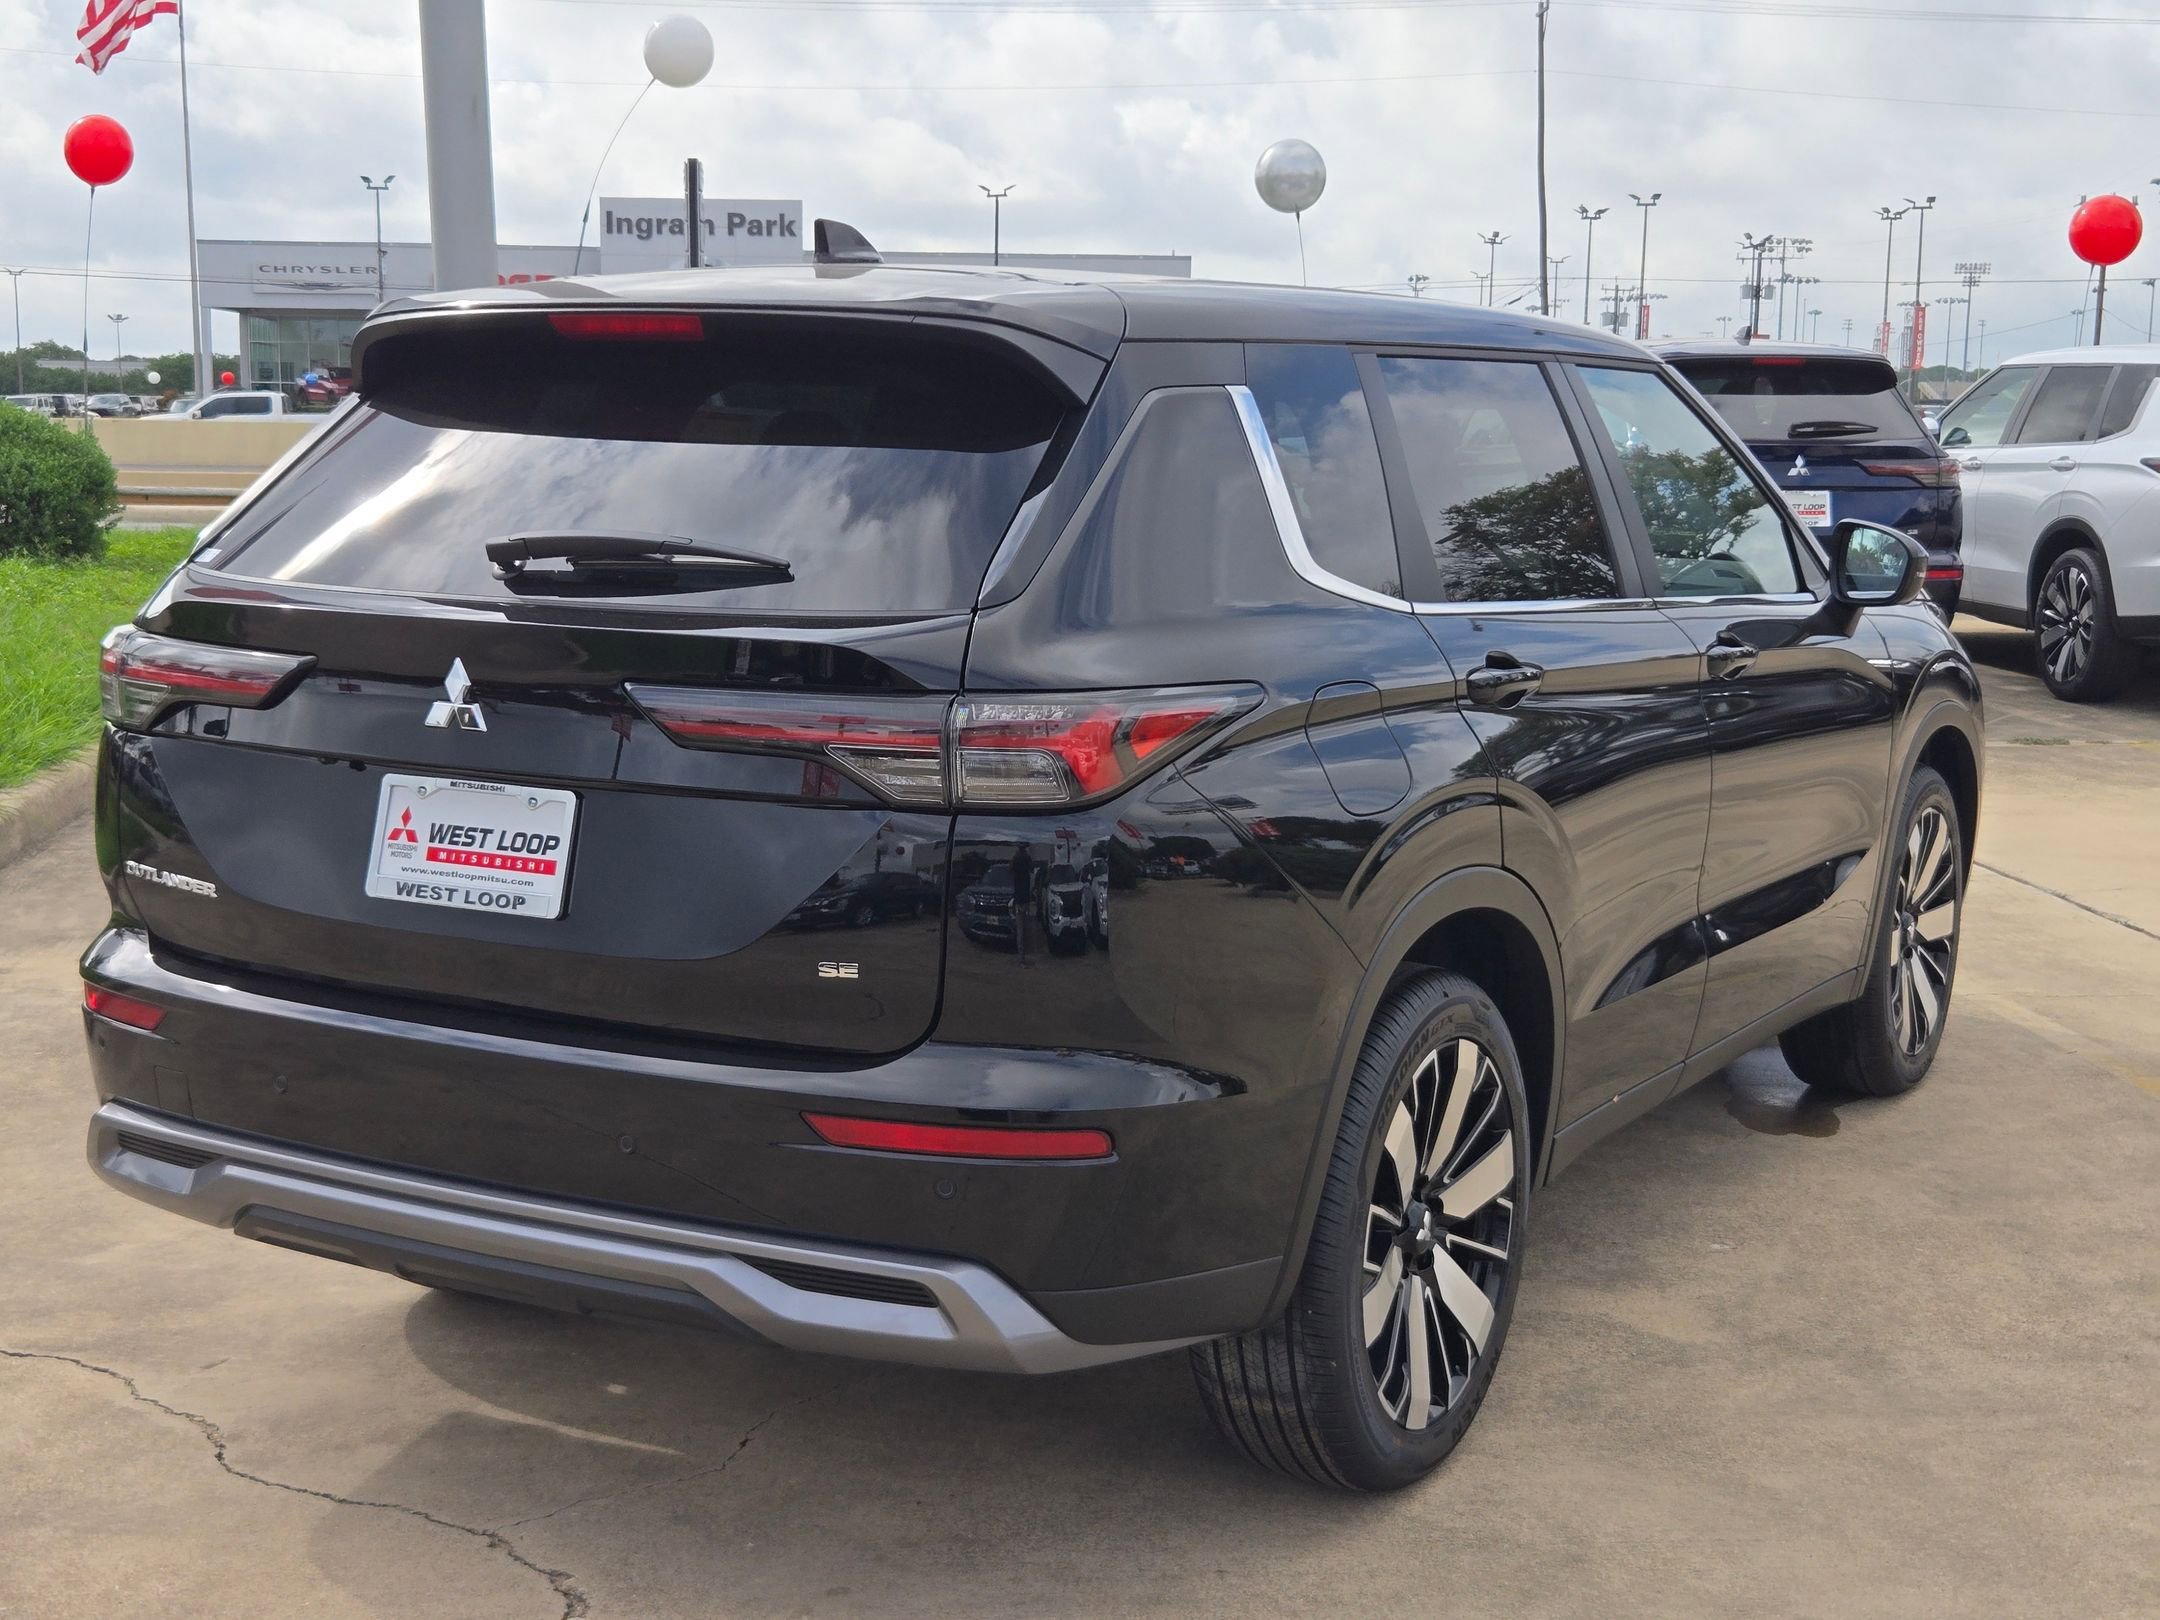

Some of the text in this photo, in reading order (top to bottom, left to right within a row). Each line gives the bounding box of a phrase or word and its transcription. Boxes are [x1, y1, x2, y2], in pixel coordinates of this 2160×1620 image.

[727, 212, 797, 237] Park
[259, 264, 378, 275] CHRYSLER
[449, 780, 507, 793] MITSUBISHI
[387, 843, 418, 853] MITSUBISHI
[428, 822, 561, 856] WEST LOOP
[390, 851, 413, 859] MOTORS
[438, 851, 546, 872] MITSUBISHI
[124, 860, 218, 898] OUTLANDER
[401, 865, 535, 887] www.westloopmitsu.com
[395, 880, 527, 910] WEST LOOP
[818, 961, 859, 979] SE
